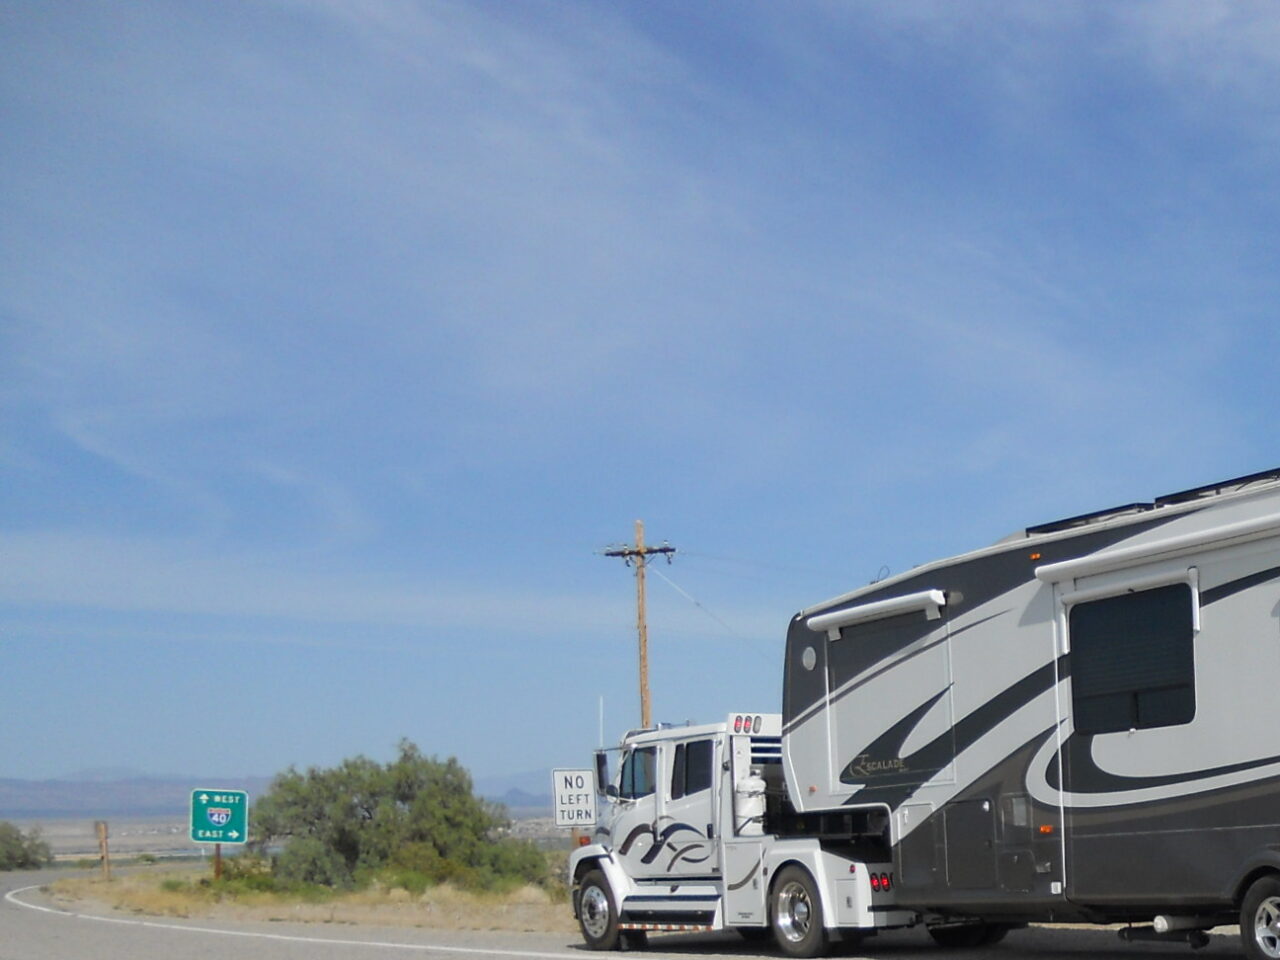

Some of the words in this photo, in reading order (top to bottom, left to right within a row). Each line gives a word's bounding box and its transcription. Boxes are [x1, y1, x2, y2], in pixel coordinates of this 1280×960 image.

[850, 753, 905, 777] ESCALADE
[564, 775, 584, 789] NO
[213, 795, 240, 803] WEST
[560, 794, 590, 805] LEFT
[211, 813, 227, 822] 40
[560, 809, 592, 820] TURN
[198, 830, 224, 838] EAST
